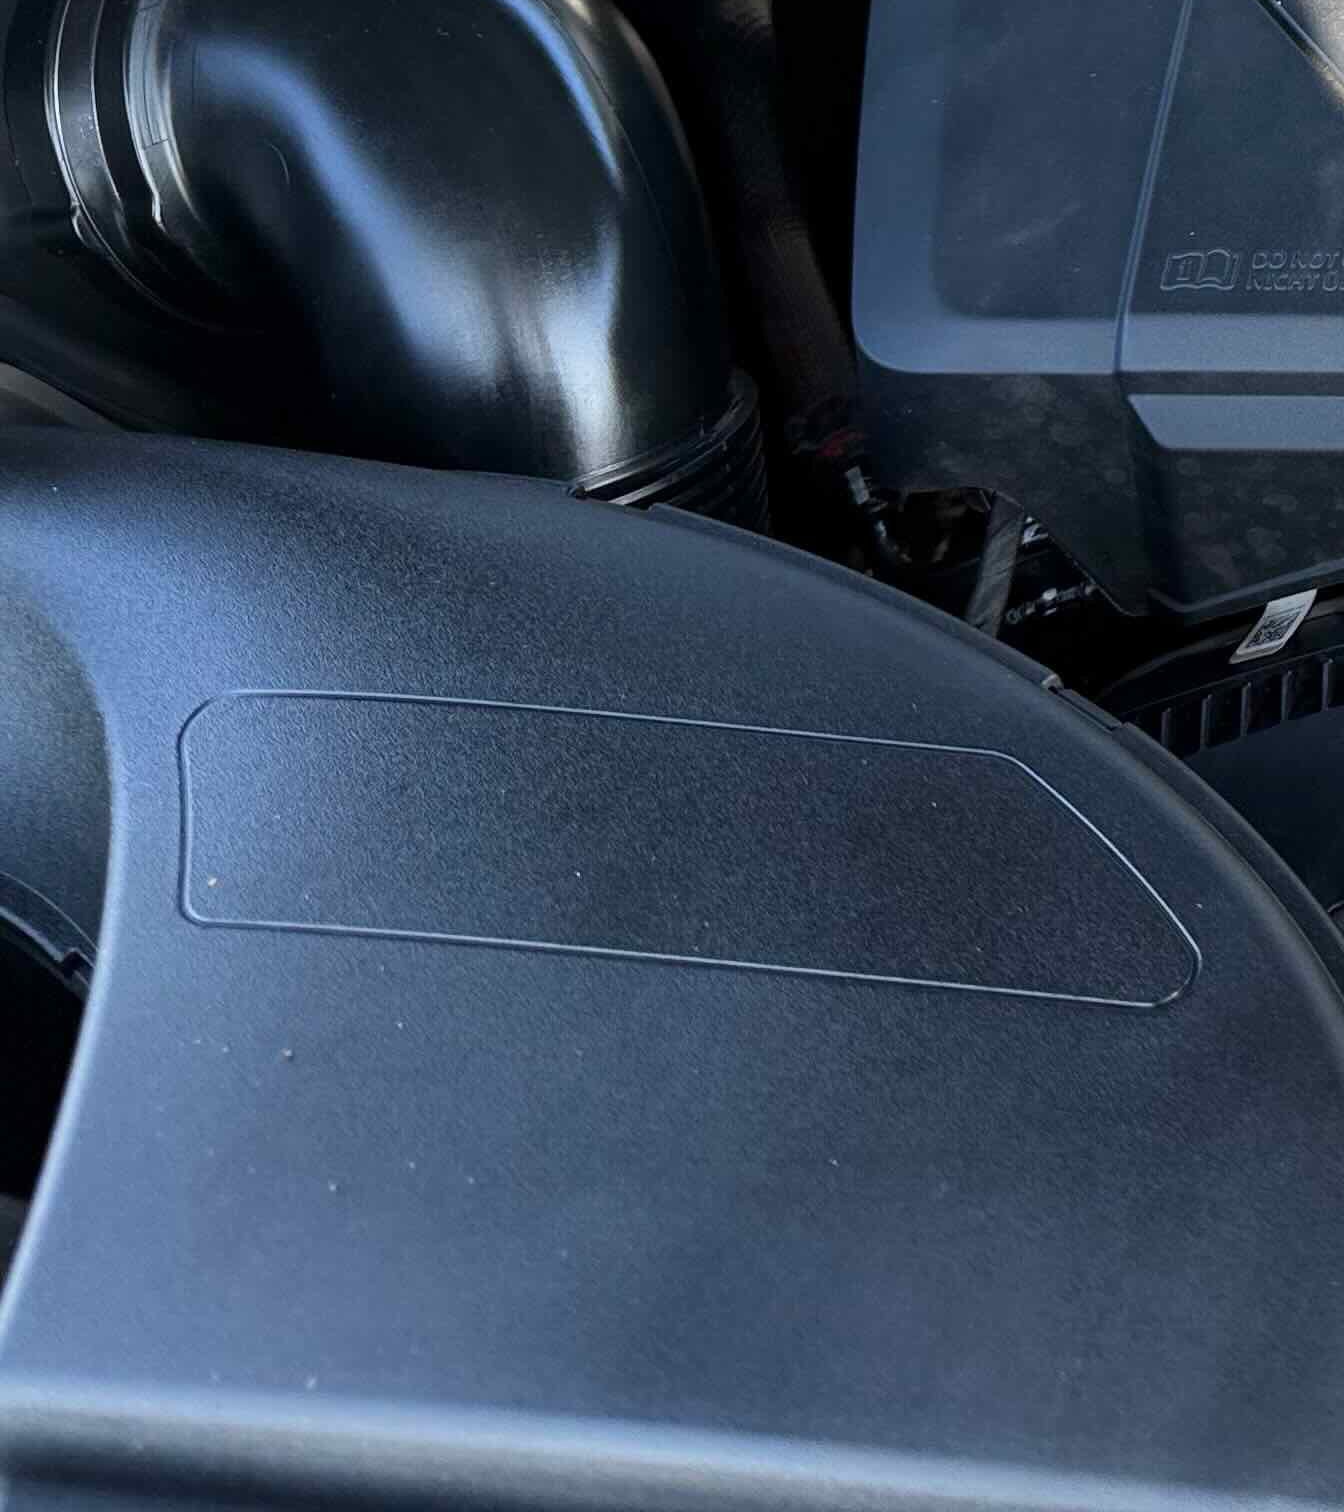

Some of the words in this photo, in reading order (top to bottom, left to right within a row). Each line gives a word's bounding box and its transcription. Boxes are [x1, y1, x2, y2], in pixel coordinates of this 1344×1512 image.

[1251, 250, 1287, 270] DO
[1289, 250, 1339, 270] NOT
[1245, 271, 1320, 291] NICHT
